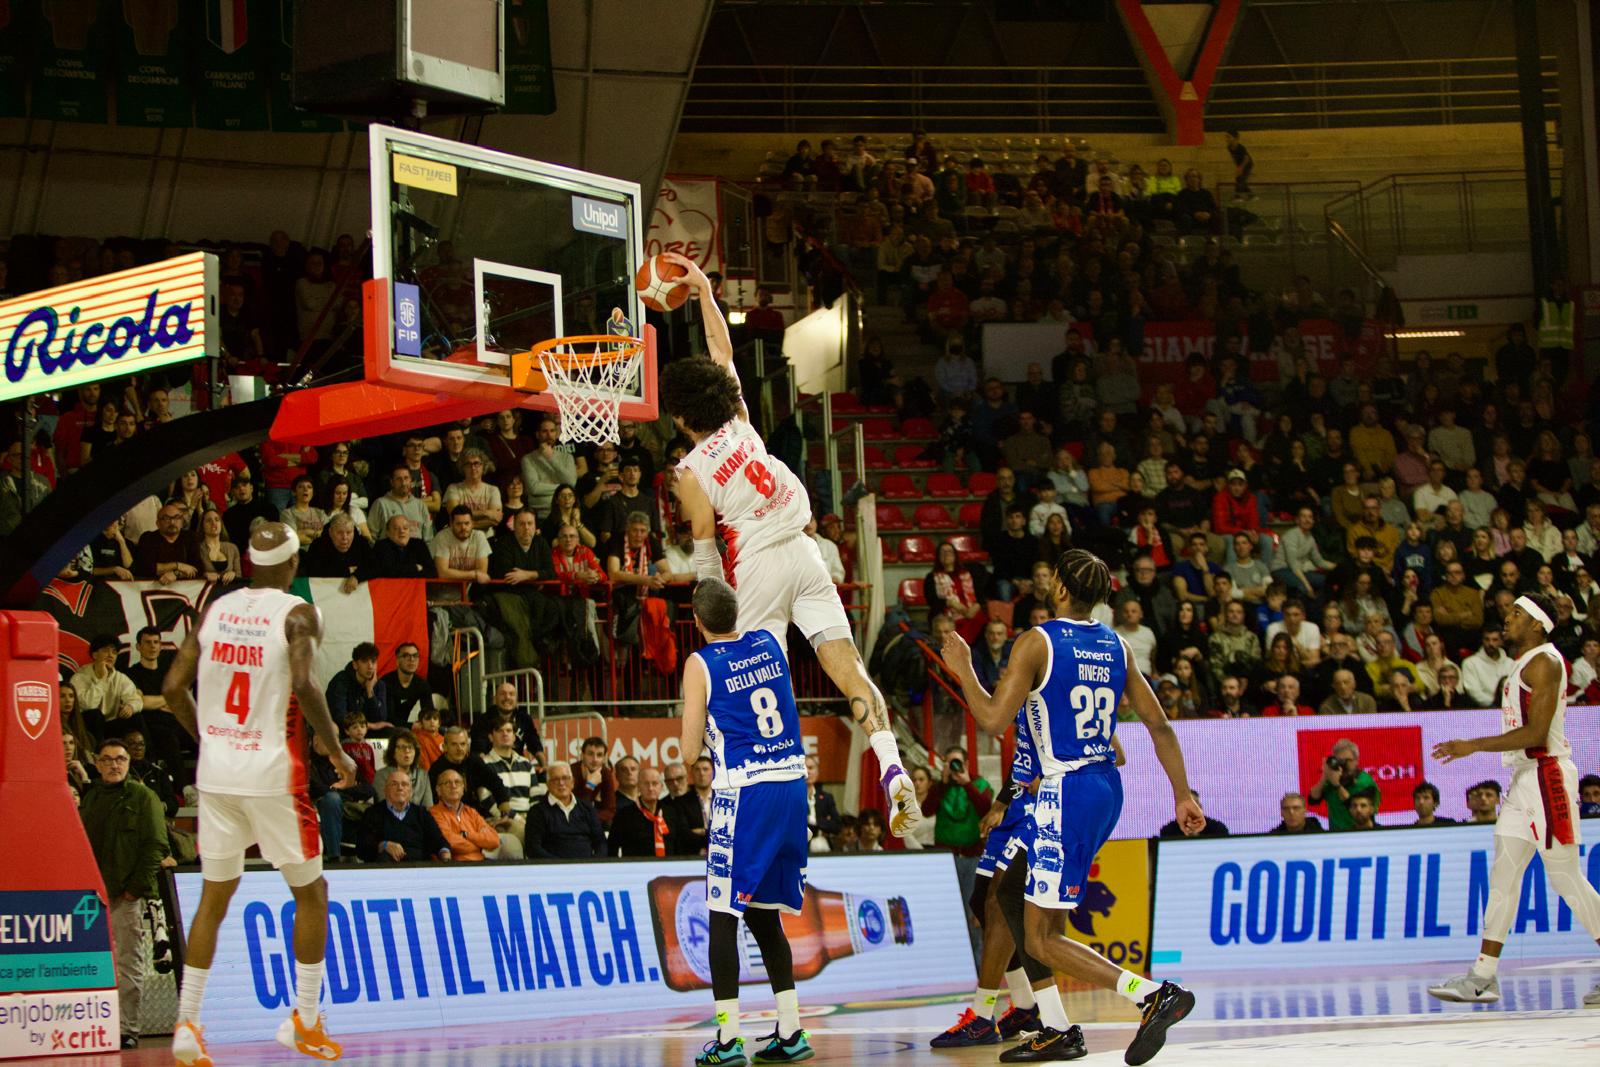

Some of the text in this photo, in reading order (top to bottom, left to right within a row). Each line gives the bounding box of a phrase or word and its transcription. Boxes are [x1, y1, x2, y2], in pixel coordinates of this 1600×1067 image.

[400, 163, 451, 182] FASTWEB
[584, 203, 619, 231] Unipol
[5, 288, 194, 382] Ricola
[399, 329, 419, 342] FIP
[1139, 334, 1218, 363] SIAM
[744, 460, 776, 499] 8
[725, 661, 783, 694] DELLA VALLE
[1079, 663, 1110, 683] RIVERS
[225, 671, 250, 726] 4
[750, 687, 784, 739] 8
[1070, 685, 1115, 742] 23
[568, 736, 684, 769] SAMO
[1210, 855, 1389, 945] GODITI
[1404, 853, 1450, 938] IL
[429, 896, 486, 997] IL
[483, 890, 660, 993] MATCH.
[16, 967, 36, 982] per
[39, 963, 98, 979] l'ambiente
[30, 1030, 46, 1046] by
